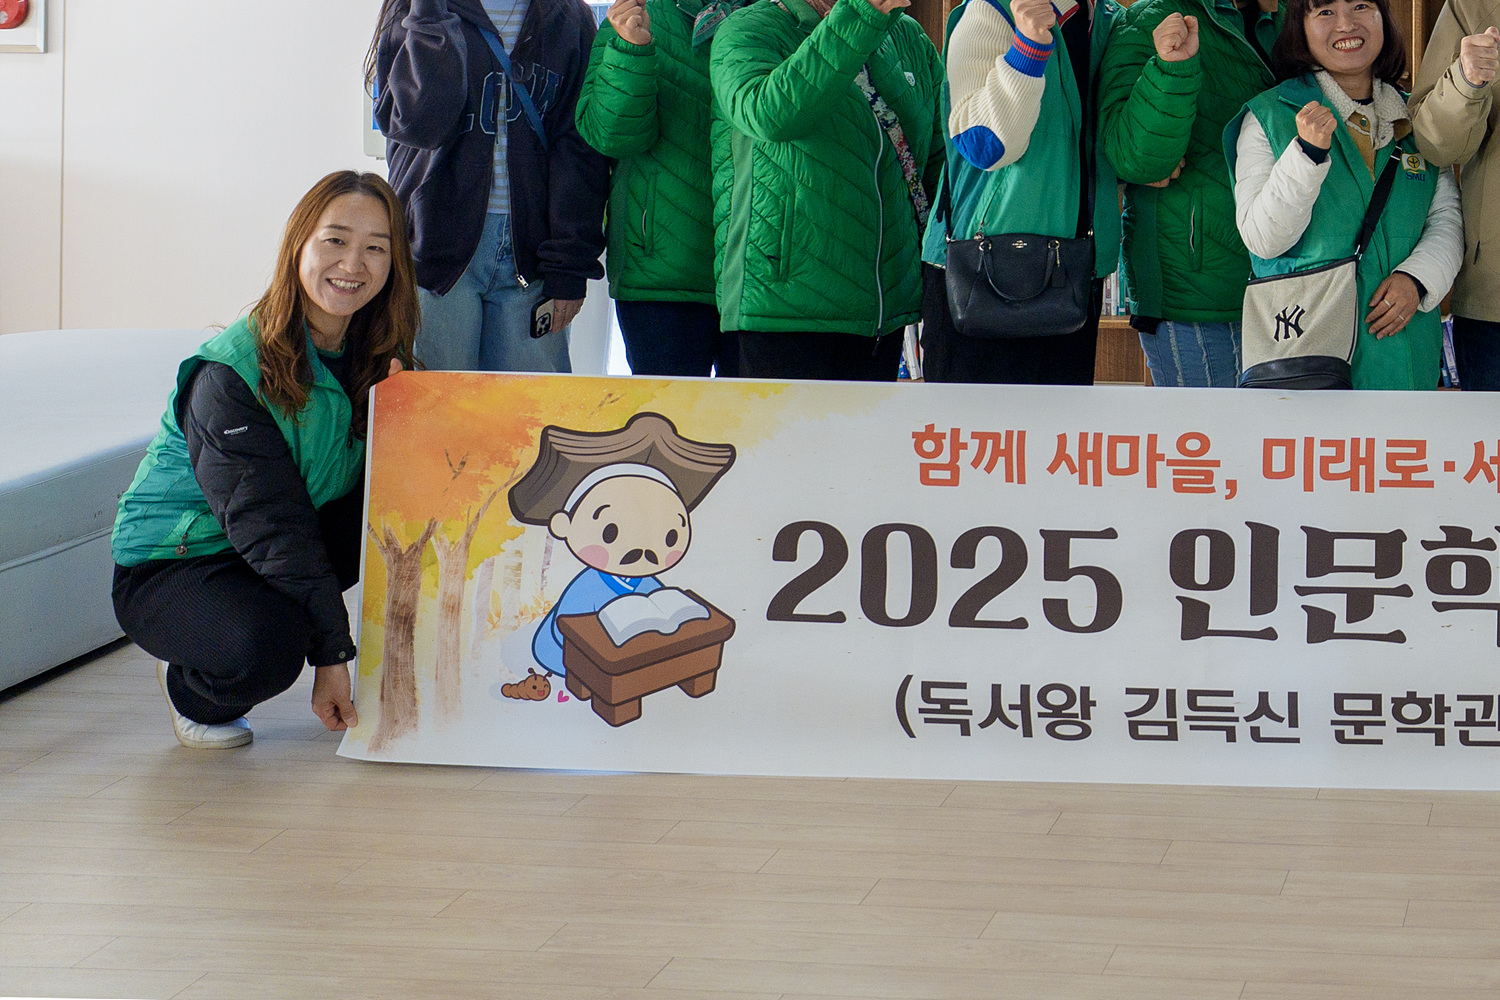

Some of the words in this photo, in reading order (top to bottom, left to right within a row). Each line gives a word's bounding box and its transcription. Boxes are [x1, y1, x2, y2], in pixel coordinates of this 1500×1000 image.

[1406, 172, 1426, 182] SMU
[911, 423, 1028, 487] 함께
[1047, 431, 1239, 501] 새마을,
[766, 520, 1123, 634] 2025
[895, 674, 1097, 741] (독서왕
[1124, 687, 1301, 744] 김득신
